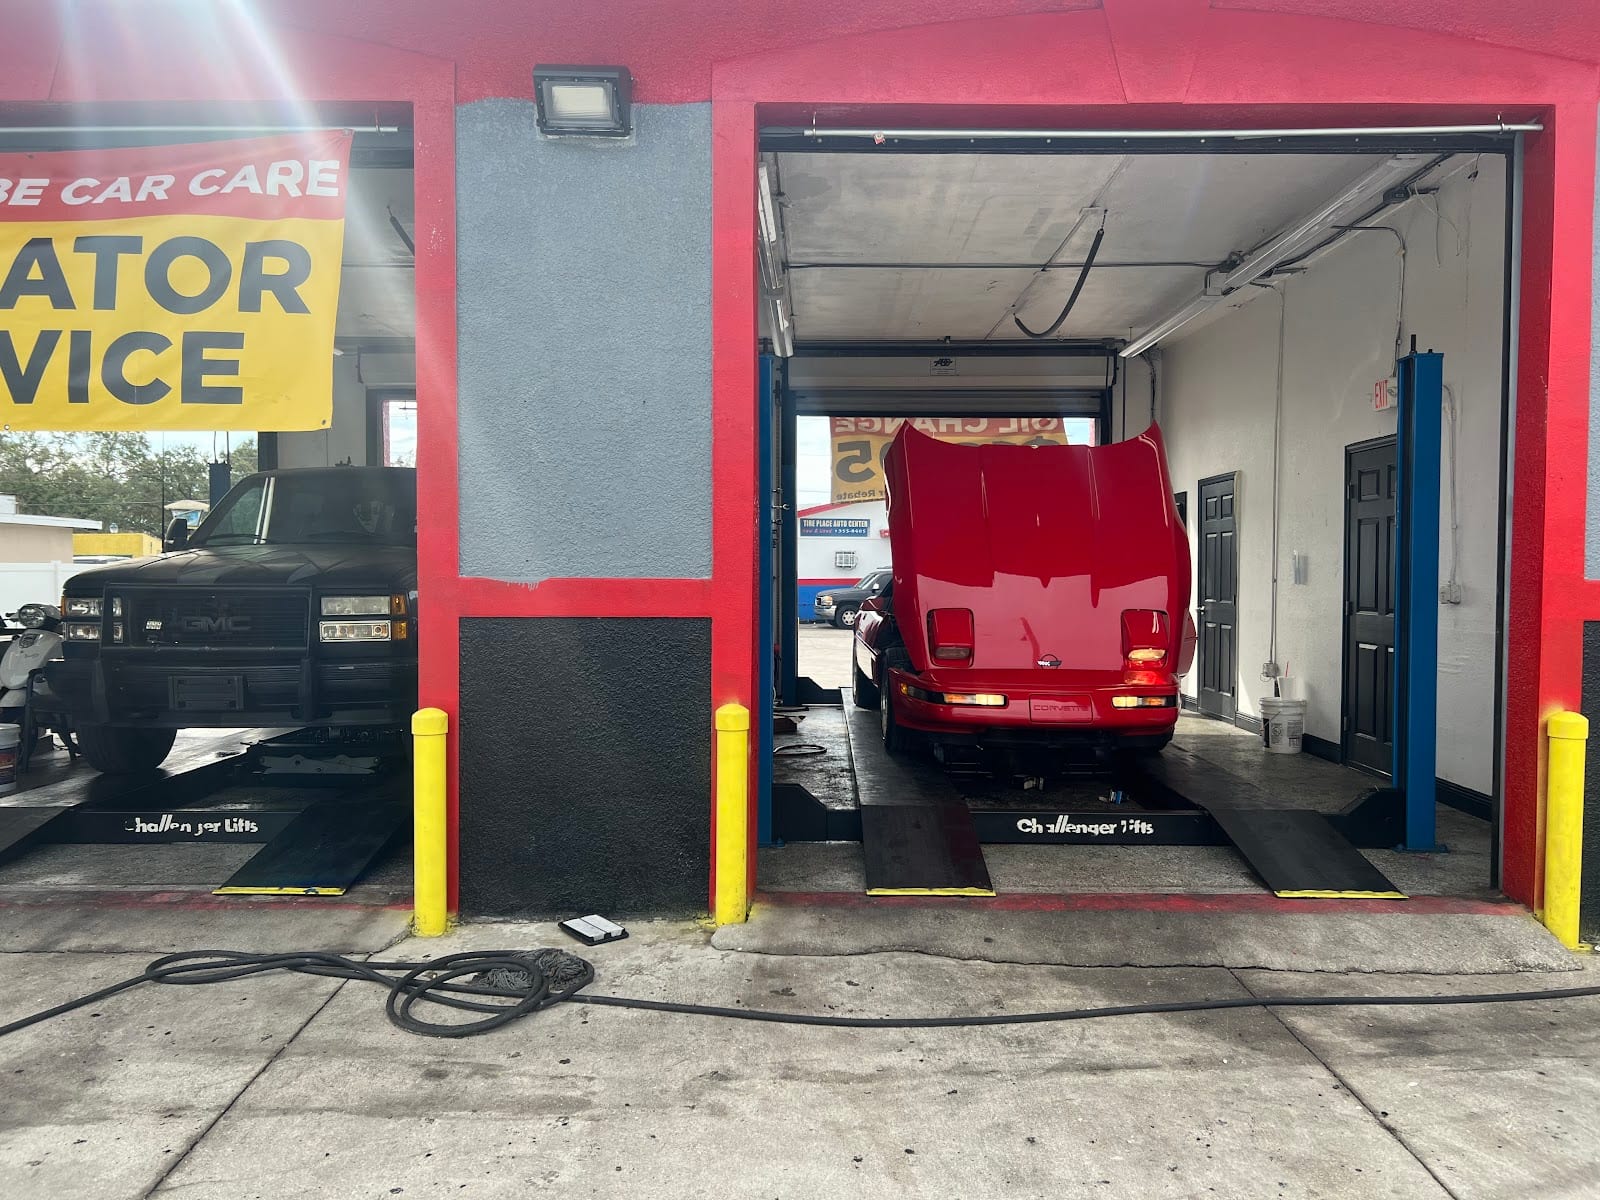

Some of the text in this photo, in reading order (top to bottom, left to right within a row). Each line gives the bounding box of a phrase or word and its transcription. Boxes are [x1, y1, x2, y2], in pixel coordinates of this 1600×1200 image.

[60, 174, 176, 205] CAR
[187, 158, 341, 198] CARE
[0, 235, 312, 315] ATOR
[0, 329, 246, 406] VICE
[1374, 379, 1388, 409] EXIT
[803, 519, 815, 527] TIRE
[848, 520, 868, 528] CENTER
[183, 616, 252, 632] GMC
[1033, 704, 1089, 712] CORVETTE
[125, 814, 259, 836] hallenger Lifts
[1016, 814, 1118, 836] Challenger
